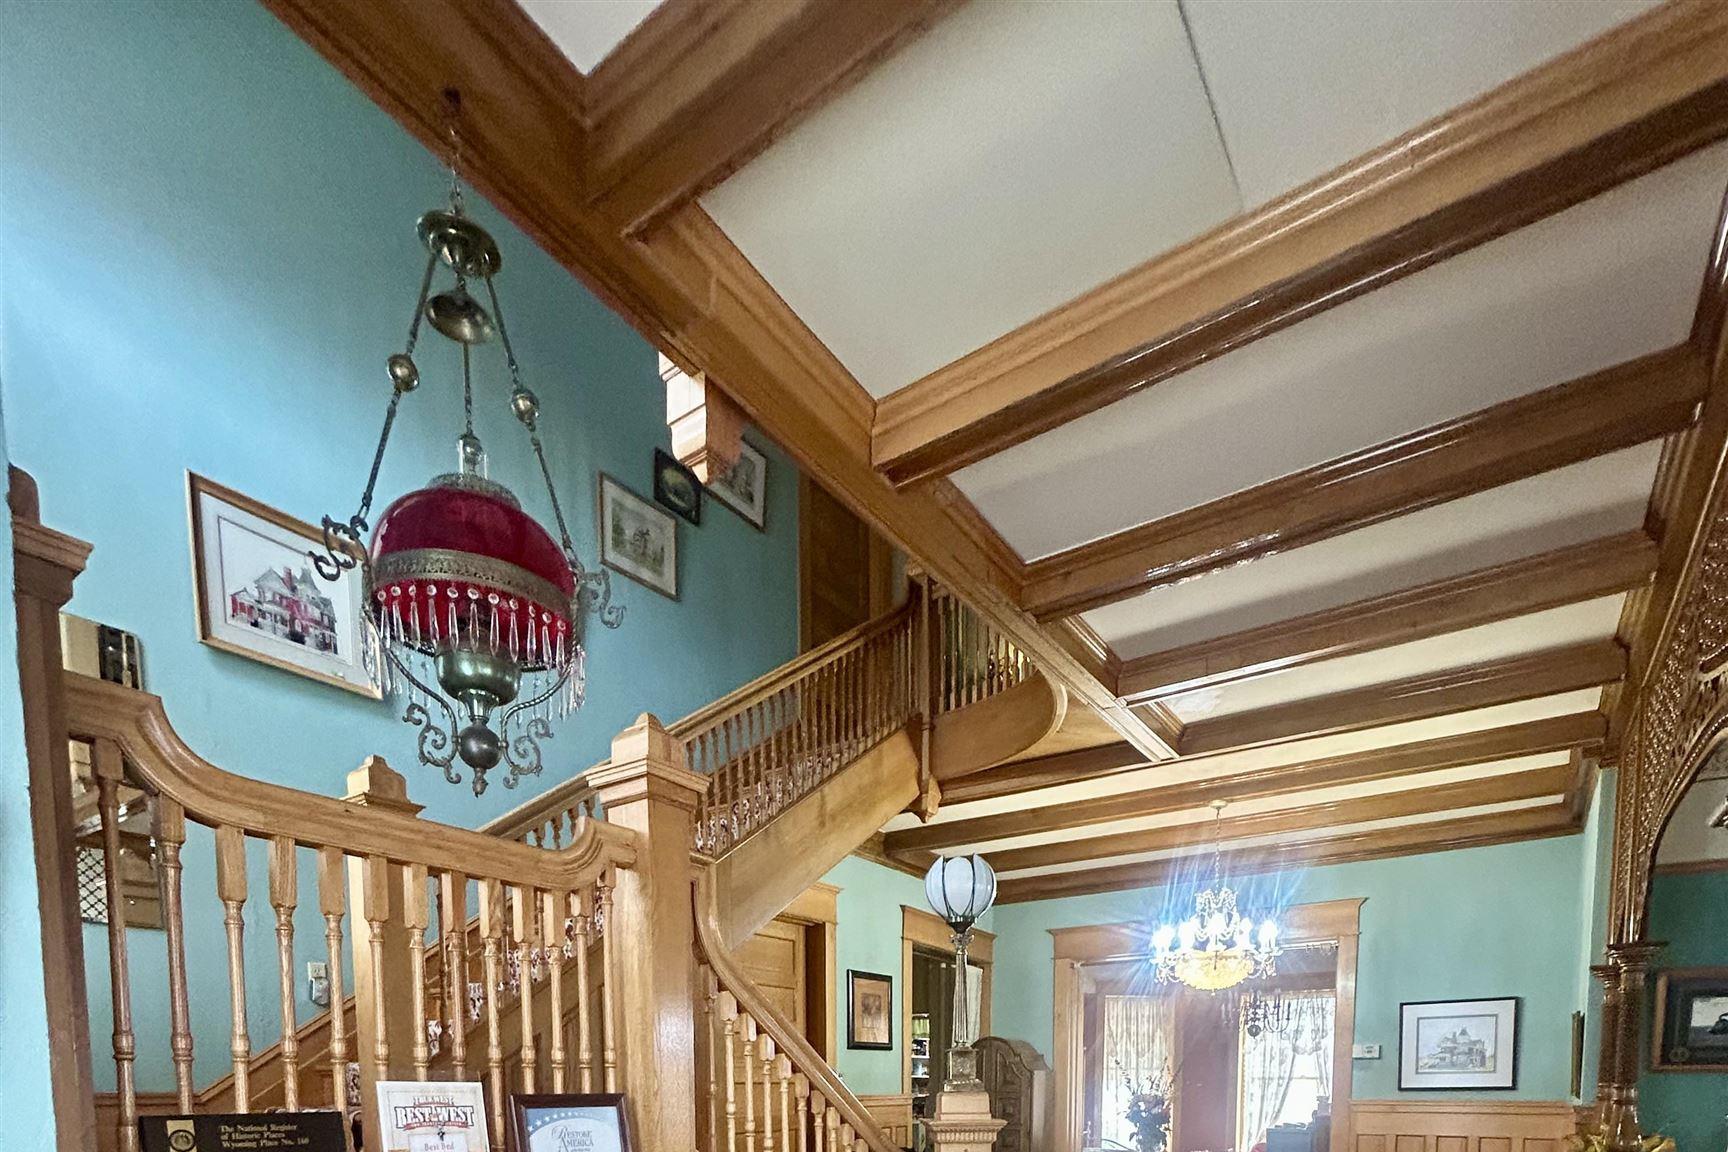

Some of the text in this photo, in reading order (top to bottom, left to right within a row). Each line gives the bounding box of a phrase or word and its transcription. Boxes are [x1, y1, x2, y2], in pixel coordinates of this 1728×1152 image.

[394, 1106, 432, 1129] BEST
[435, 1105, 475, 1126] WEST
[237, 1124, 267, 1132] National
[270, 1123, 297, 1132] Register
[231, 1132, 260, 1140] Historic
[221, 1140, 257, 1149] Wyoming
[424, 1141, 455, 1151] Best Bed
